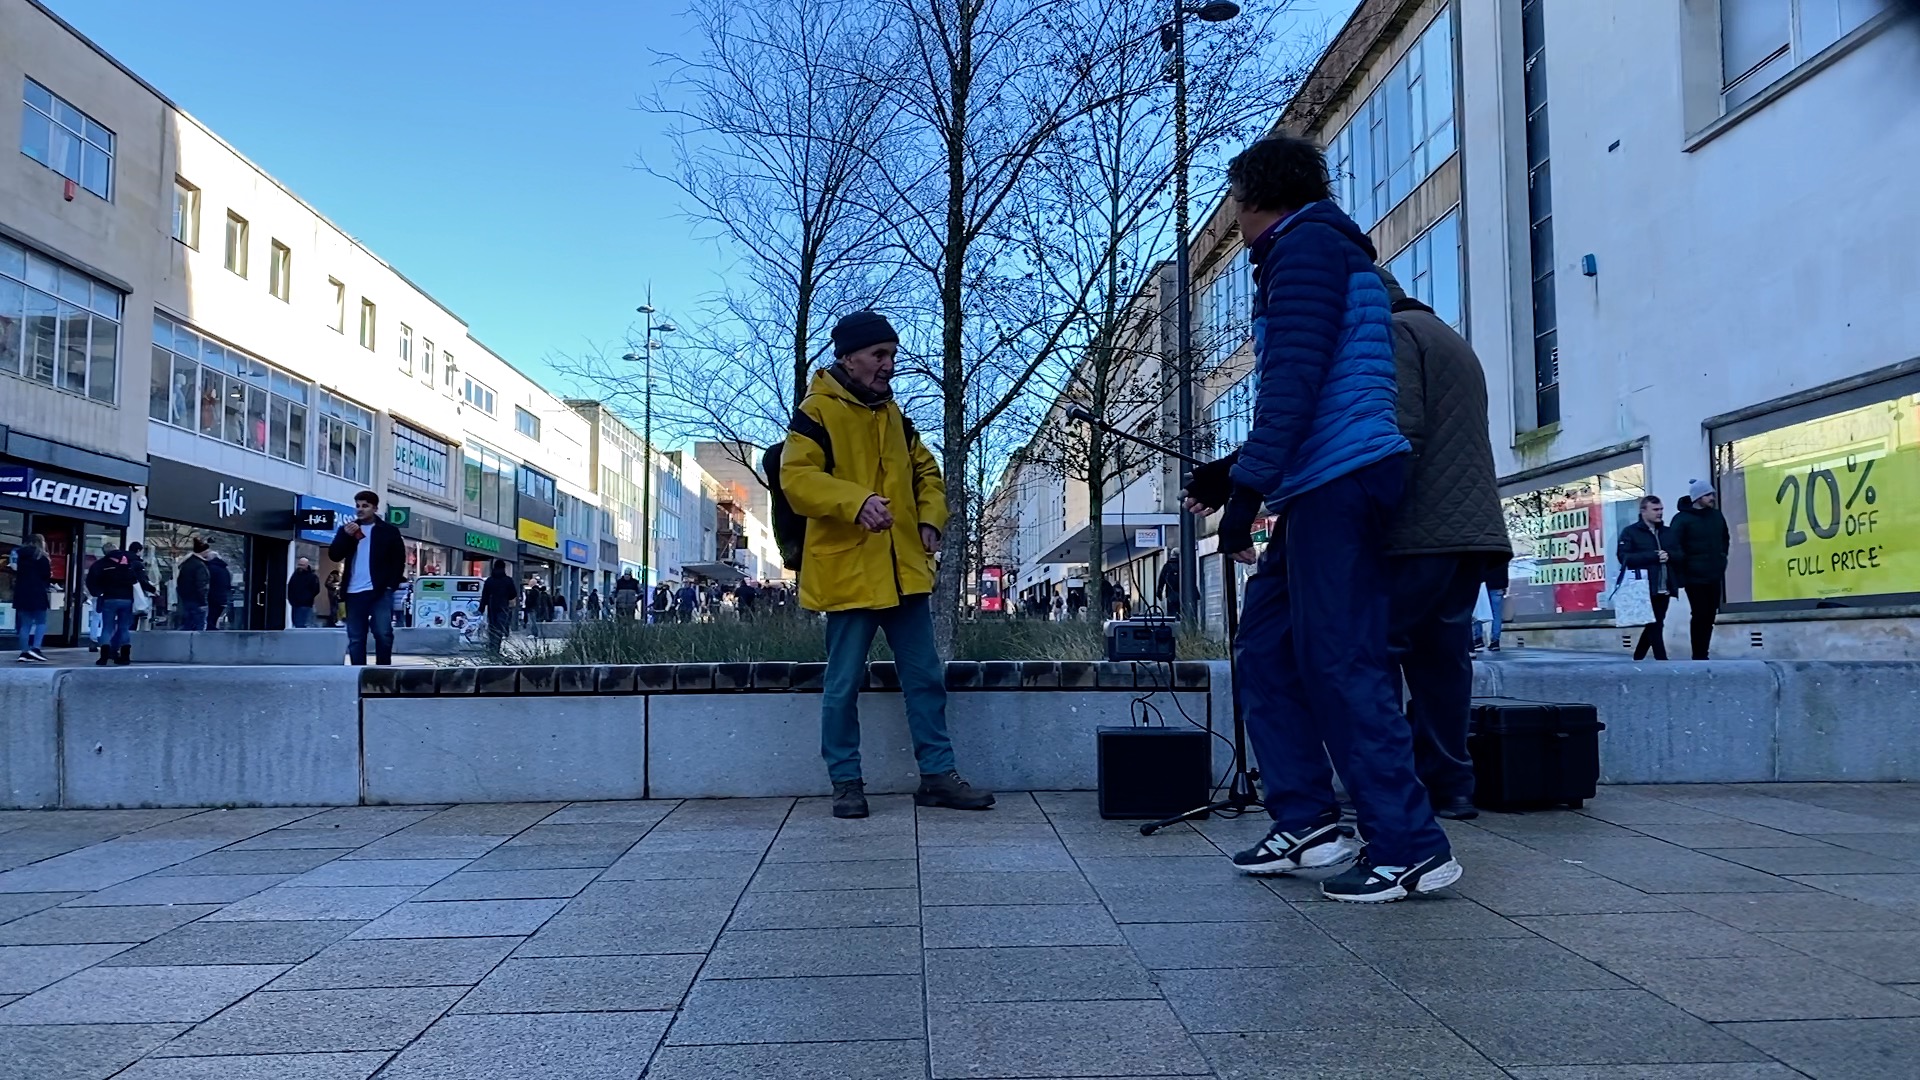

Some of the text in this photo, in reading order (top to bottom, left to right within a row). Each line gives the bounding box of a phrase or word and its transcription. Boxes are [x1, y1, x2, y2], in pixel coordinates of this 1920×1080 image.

[395, 445, 442, 476] DEICHMANN
[2, 478, 128, 514] KECHERS
[1776, 454, 1877, 548] 20%
[1845, 510, 1879, 536] OFF
[1787, 555, 1824, 577] FULL
